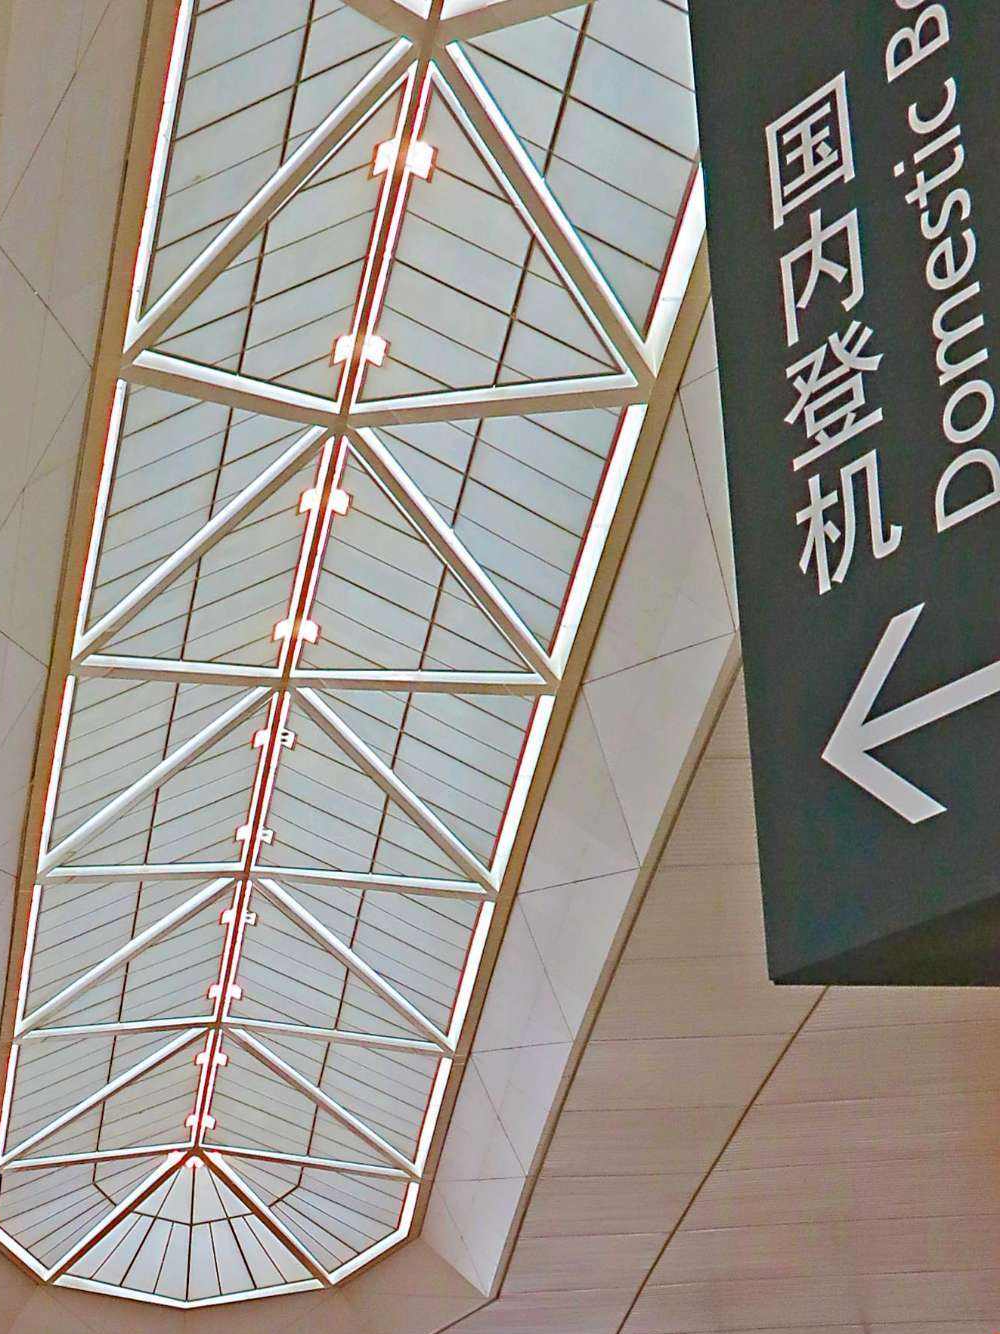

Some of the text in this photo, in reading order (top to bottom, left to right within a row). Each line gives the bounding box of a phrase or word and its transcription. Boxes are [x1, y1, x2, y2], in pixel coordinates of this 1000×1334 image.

[765, 70, 903, 595] 国内登机
[886, 0, 1000, 534] Domestic B
